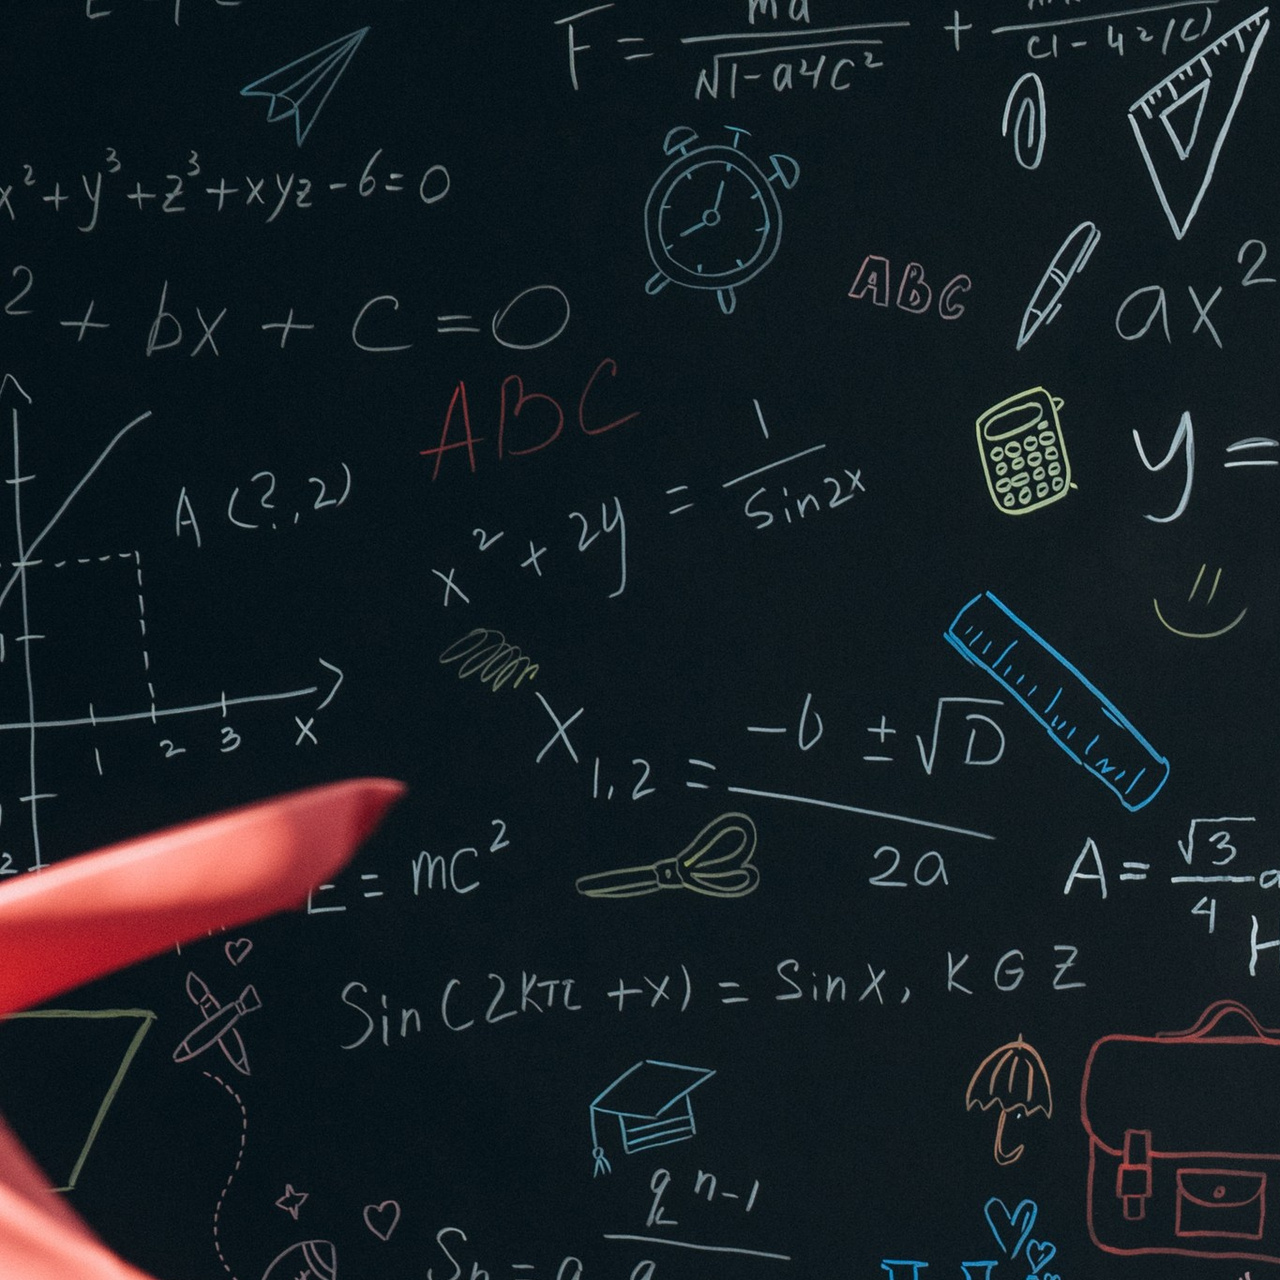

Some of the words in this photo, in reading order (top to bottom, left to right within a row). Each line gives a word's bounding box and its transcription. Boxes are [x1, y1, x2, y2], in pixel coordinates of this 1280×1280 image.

[847, 254, 972, 321] ABC
[418, 356, 642, 484] ABC
[1131, 409, 1196, 524] y
[868, 844, 950, 888] 2a
[1062, 836, 1109, 900] A
